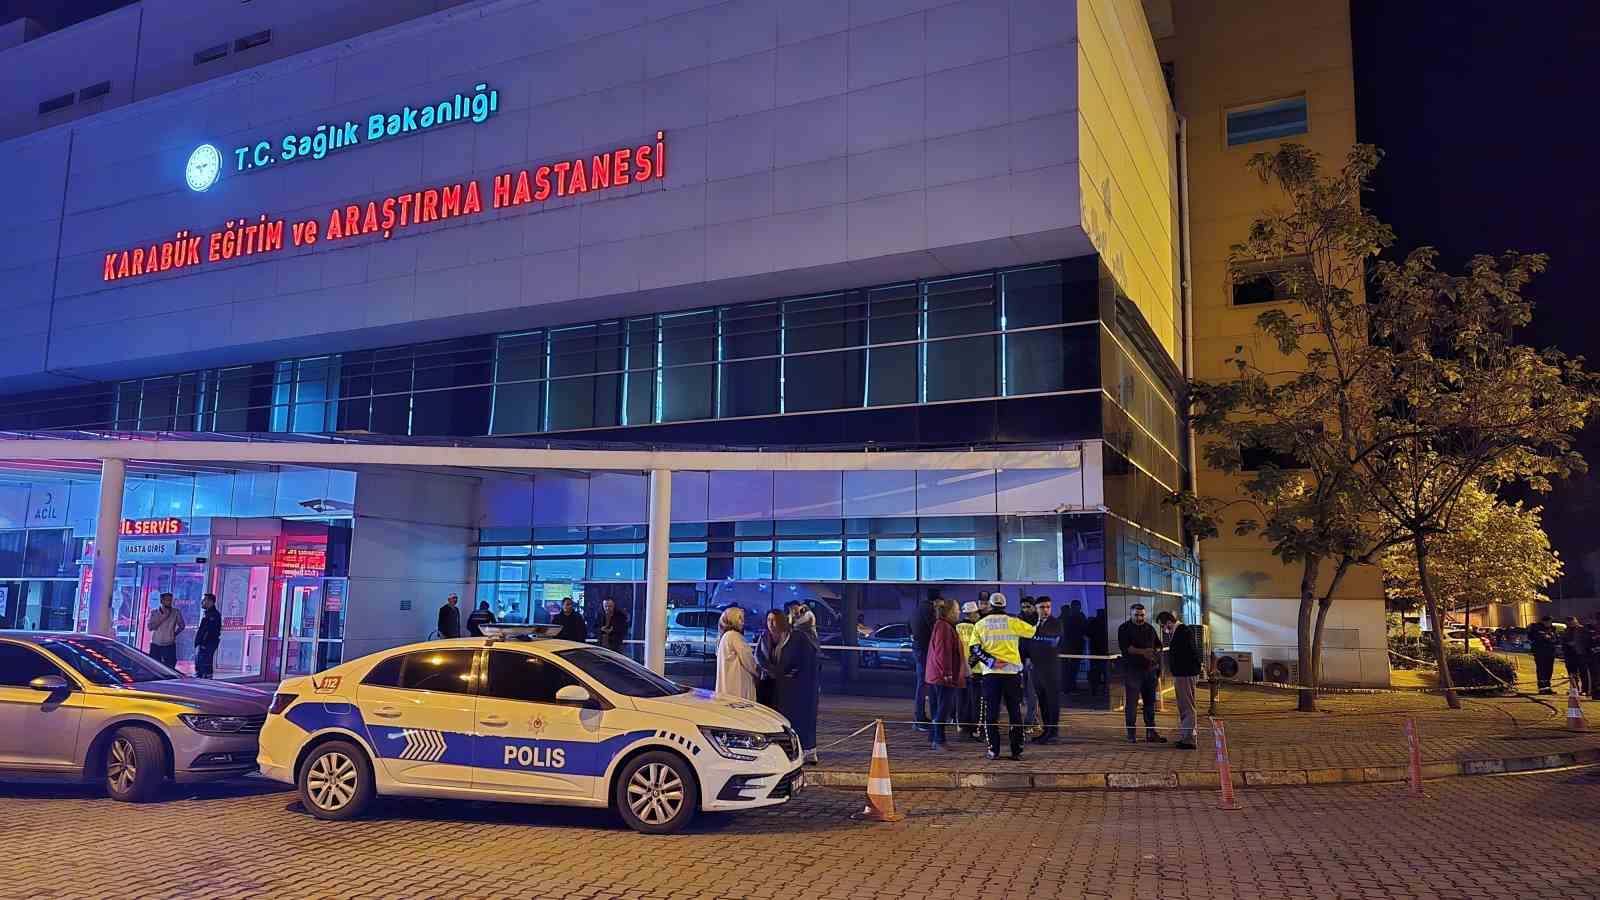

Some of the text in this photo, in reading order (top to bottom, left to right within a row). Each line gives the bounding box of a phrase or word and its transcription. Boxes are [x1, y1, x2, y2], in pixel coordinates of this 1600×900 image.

[235, 142, 275, 170] T.C.
[281, 121, 359, 160] Sağlık
[368, 84, 498, 140] Bakanlığı
[104, 131, 664, 281] KARABÜK EĞİTİM ve ARAŞTIRMA HASTANESİ
[120, 518, 179, 534] İL SERVİS
[322, 678, 337, 689] 112
[503, 745, 566, 769] POLIS
